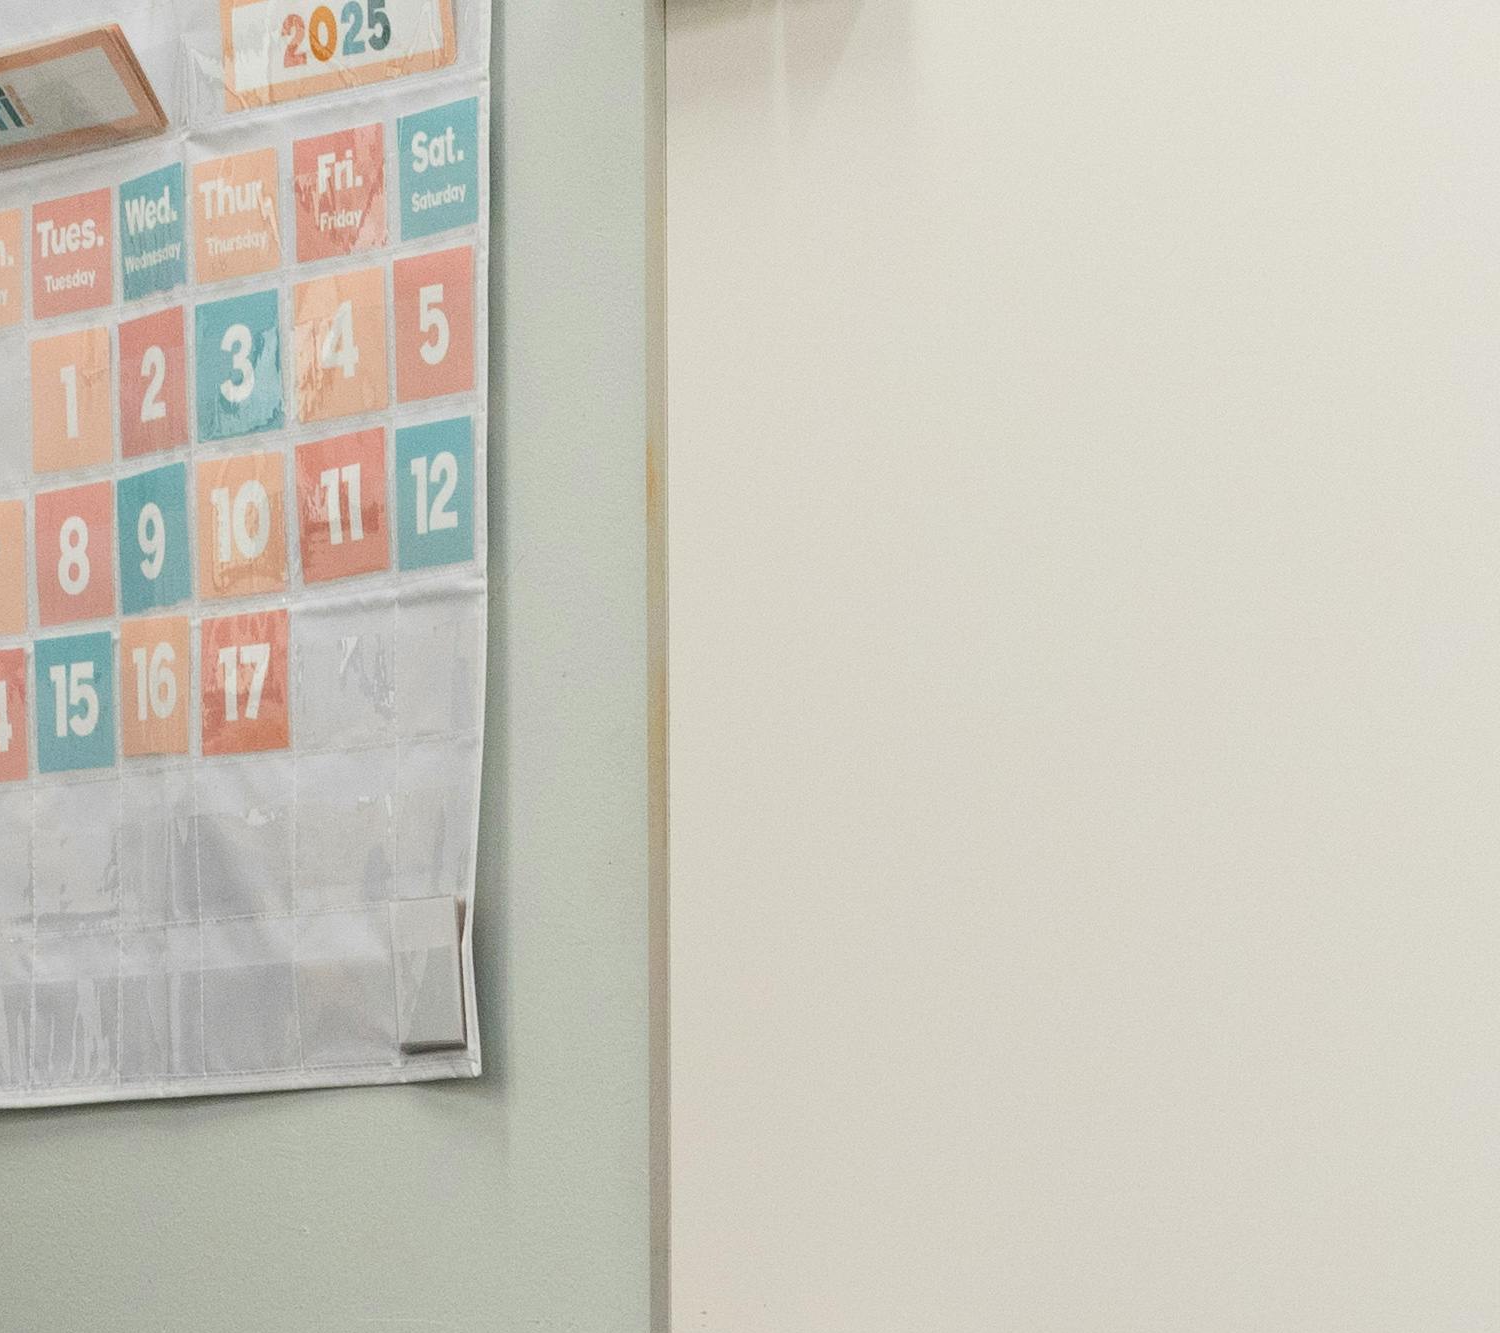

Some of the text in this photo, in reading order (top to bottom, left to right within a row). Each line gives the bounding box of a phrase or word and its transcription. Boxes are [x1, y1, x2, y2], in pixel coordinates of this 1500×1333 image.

[281, 0, 392, 69] 2025
[37, 217, 104, 258] Tues.
[125, 186, 178, 236] Wed.
[317, 150, 362, 195] Fri.
[411, 127, 465, 173] Sat.
[45, 268, 96, 293] Tuesday
[125, 242, 182, 274] Wednesday
[207, 229, 269, 257] Thursday
[320, 208, 362, 232] Friday
[412, 182, 466, 213] Saturday
[60, 283, 450, 438] 1 2 3 4 5
[59, 517, 91, 594] 8
[137, 504, 165, 580] 9
[211, 480, 270, 563] 10
[320, 464, 364, 546] 11
[411, 451, 458, 535] 12
[50, 662, 99, 738] 15
[132, 642, 177, 721] 16
[218, 643, 270, 722] 17
